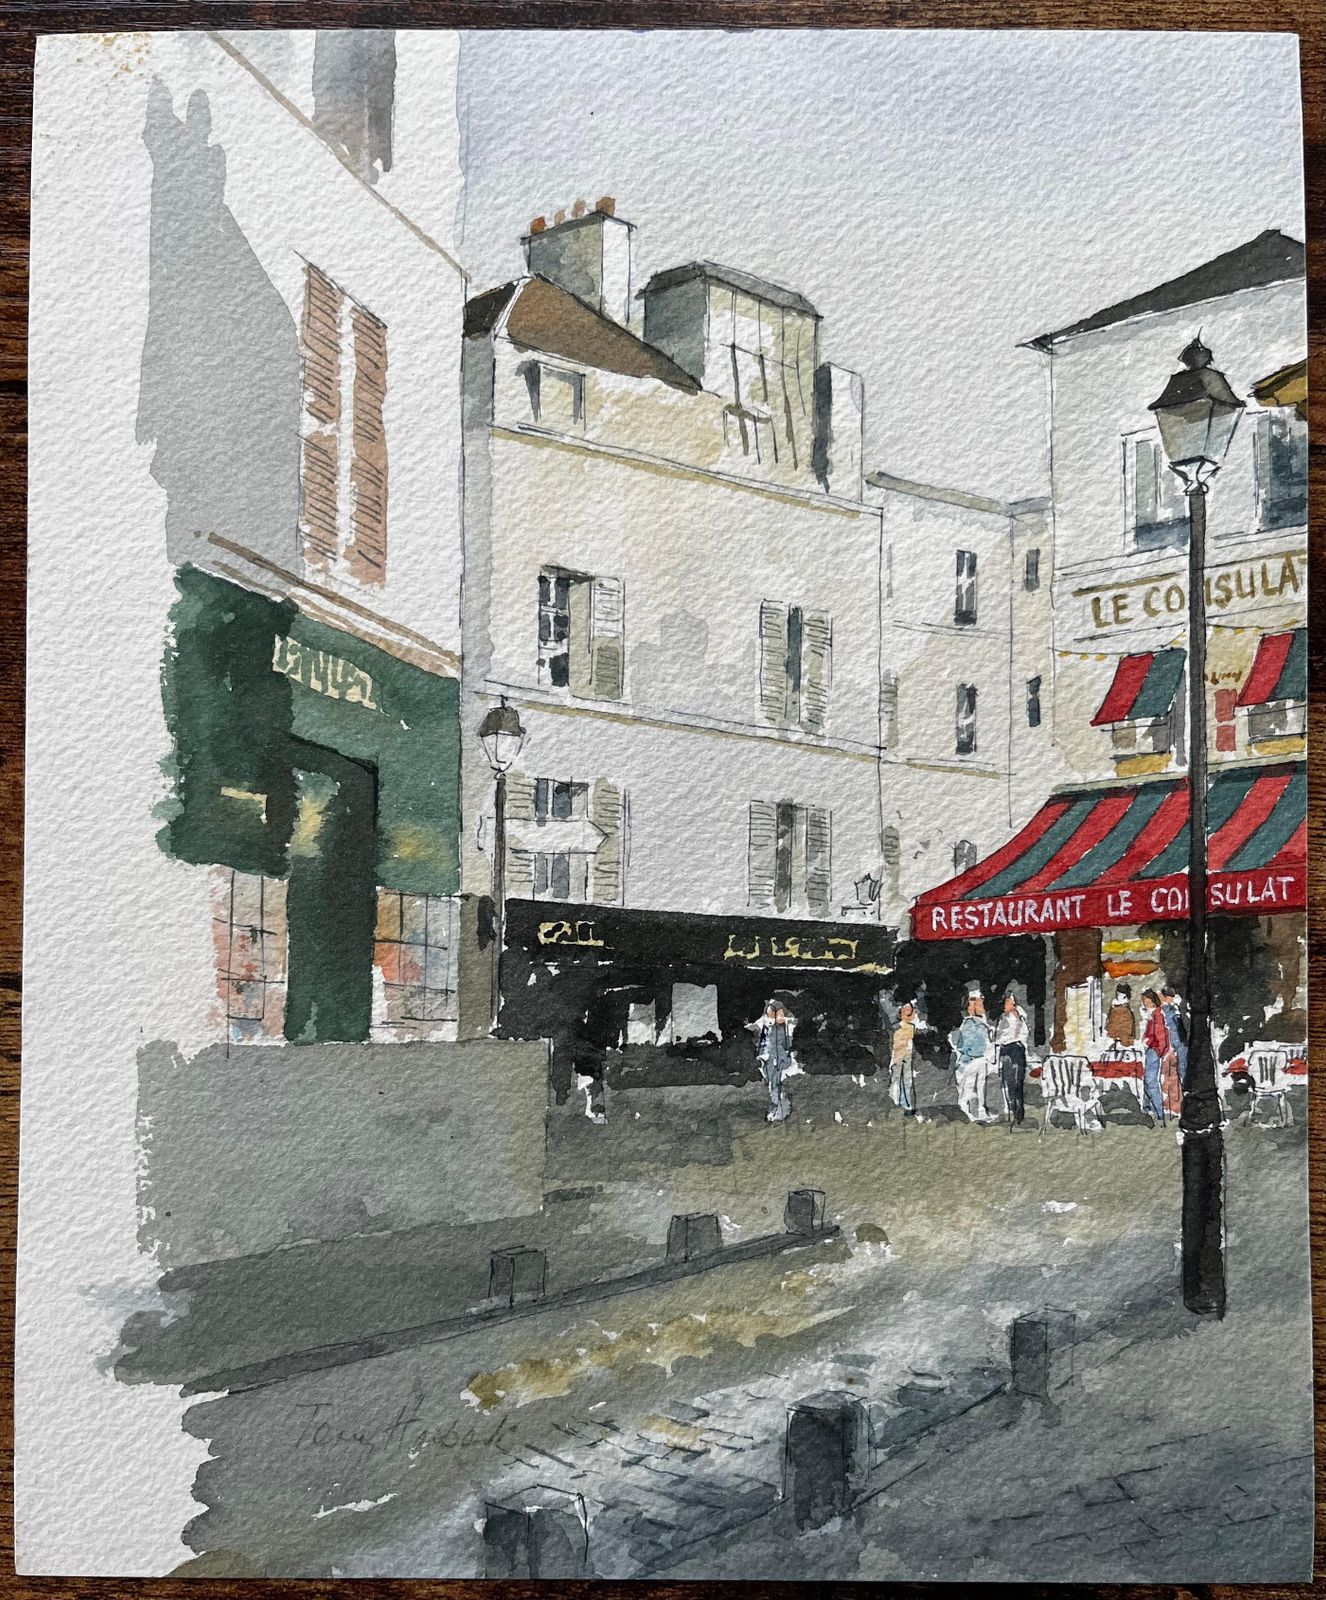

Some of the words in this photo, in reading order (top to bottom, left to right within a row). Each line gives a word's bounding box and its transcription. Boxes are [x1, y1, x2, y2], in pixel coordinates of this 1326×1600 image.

[1090, 593, 1134, 629] LE
[931, 894, 1087, 932] RESTAURANT
[1106, 890, 1132, 917] LE
